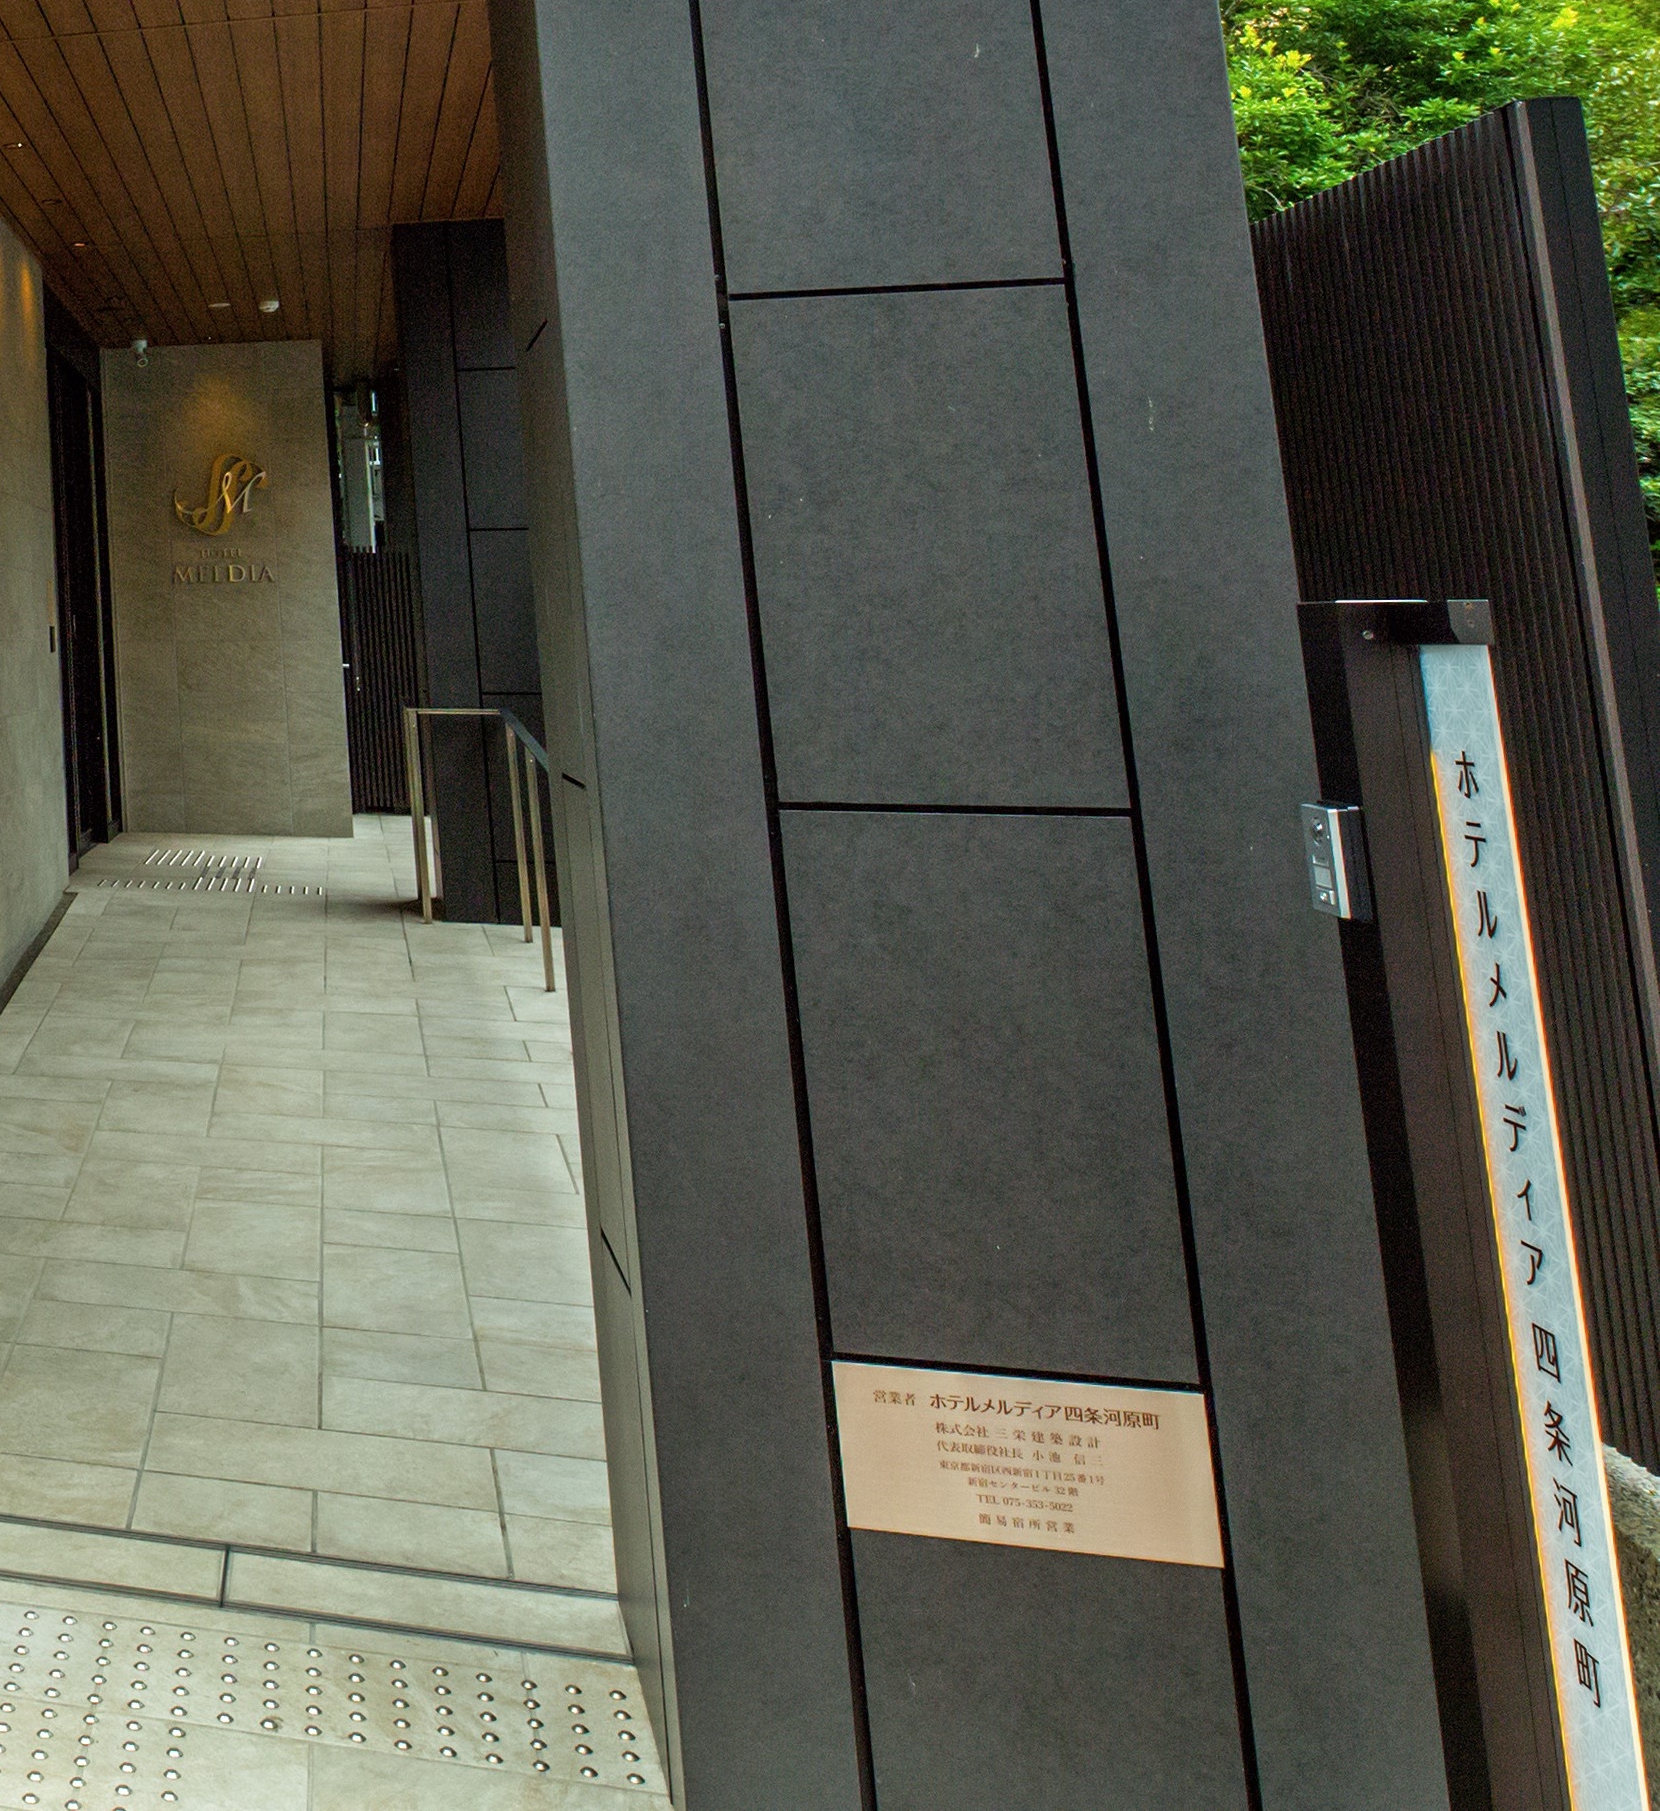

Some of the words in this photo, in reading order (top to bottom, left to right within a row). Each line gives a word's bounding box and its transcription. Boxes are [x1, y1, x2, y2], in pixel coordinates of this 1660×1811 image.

[172, 564, 276, 583] MELDIA
[1453, 750, 1603, 1708] ホテルメルディア四条河原町
[873, 1390, 916, 1406] 営業者
[929, 1393, 1160, 1430] ホテルメルディア四条河原町
[976, 1493, 1000, 1506] TEL
